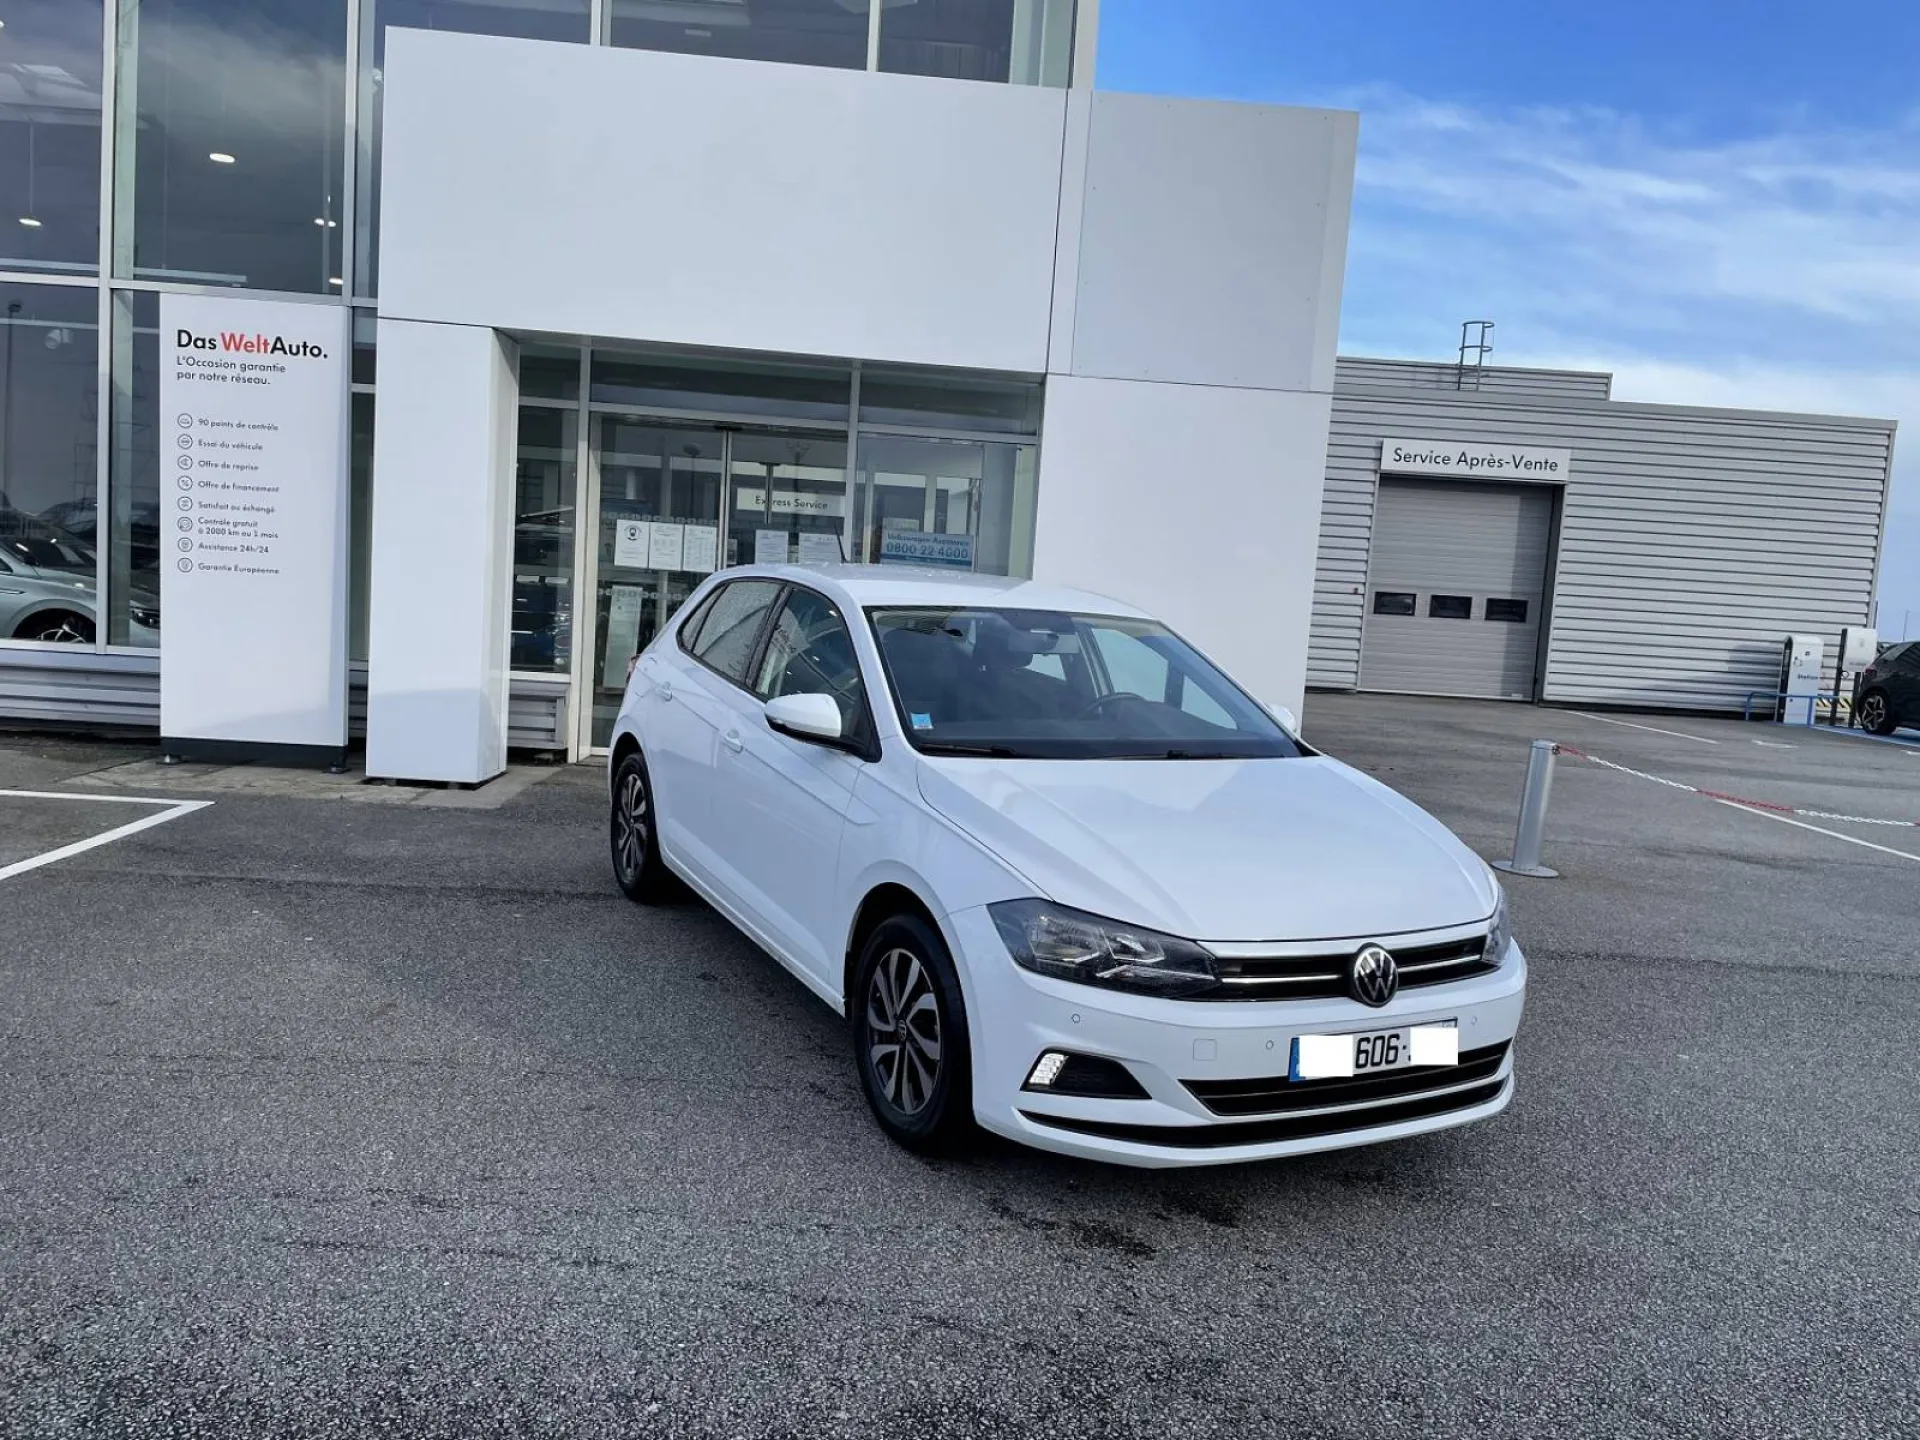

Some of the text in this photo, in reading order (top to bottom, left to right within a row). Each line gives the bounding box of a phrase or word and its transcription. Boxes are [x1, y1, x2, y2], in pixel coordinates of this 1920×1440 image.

[177, 329, 328, 359] Das WeltAuto.
[176, 355, 286, 373] L'Occasion garantie
[176, 371, 271, 385] par notre réseau.
[198, 418, 279, 431] 90 points de contrôle
[220, 441, 230, 449] du
[232, 442, 263, 450] véhicule
[198, 460, 259, 471] Offre de reprise
[1393, 447, 1558, 471] Service Après-Vente
[198, 480, 219, 488] Offre
[221, 481, 231, 490] de
[755, 495, 828, 510] Exress Service
[198, 516, 258, 528] Contrôle gratuit
[206, 527, 227, 535] 2000
[228, 528, 240, 536] km
[198, 542, 238, 551] Assistance
[886, 541, 917, 554] 0800
[920, 545, 935, 556] 22
[198, 562, 232, 571] Garantie
[1355, 1033, 1401, 1069] 606
